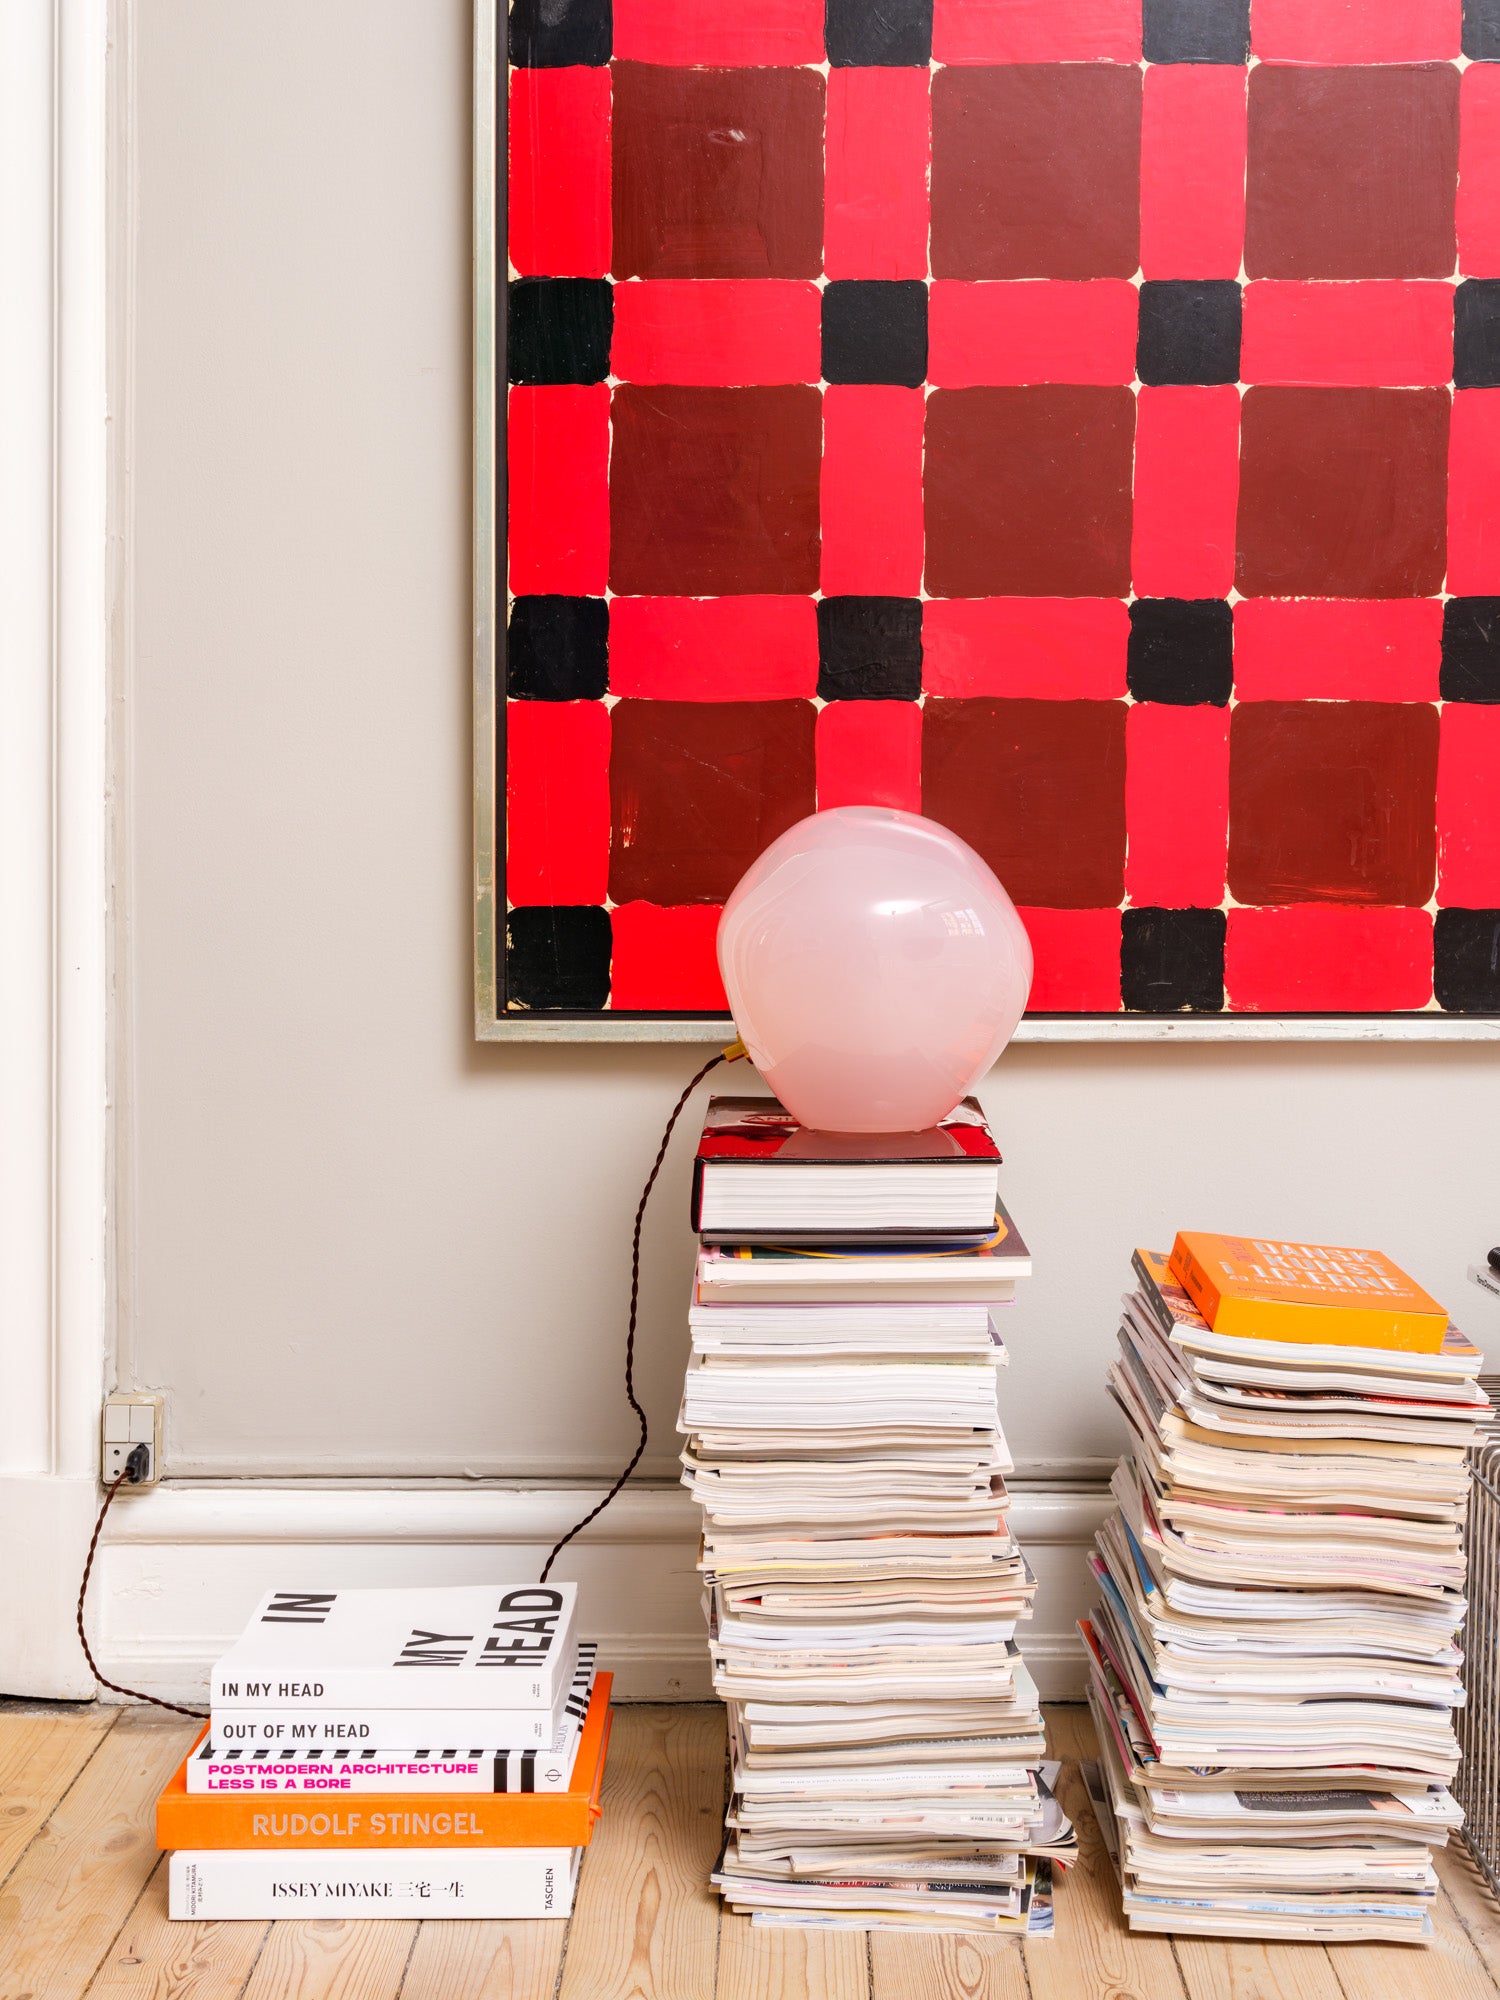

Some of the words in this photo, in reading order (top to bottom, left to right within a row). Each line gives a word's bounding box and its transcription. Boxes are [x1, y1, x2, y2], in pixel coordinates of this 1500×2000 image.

[1252, 1241, 1381, 1264] DANSK
[1219, 1261, 1235, 1274] i
[1262, 1254, 1388, 1277] KUNST
[260, 1593, 338, 1624] IN
[474, 1588, 564, 1667] HEAD
[392, 1629, 475, 1667] MY
[222, 1683, 239, 1697] IN
[246, 1683, 272, 1697] MY
[278, 1683, 324, 1697] HEAD
[223, 1724, 257, 1739] OUT
[263, 1724, 285, 1739] OF
[292, 1724, 318, 1738] MY
[324, 1724, 370, 1738] HEAD
[208, 1764, 333, 1775] POSTMODERN
[339, 1763, 479, 1775] ARCHITECTURE
[207, 1778, 255, 1790] LESS
[260, 1778, 278, 1790] IS
[284, 1778, 297, 1789] A
[303, 1778, 351, 1789] BORE
[253, 1814, 362, 1836] RUDOLF
[370, 1812, 484, 1835] STINGEL
[272, 1882, 322, 1897] ISSEY
[325, 1882, 393, 1897] MIYAKE
[544, 1867, 554, 1911] TASCHEN
